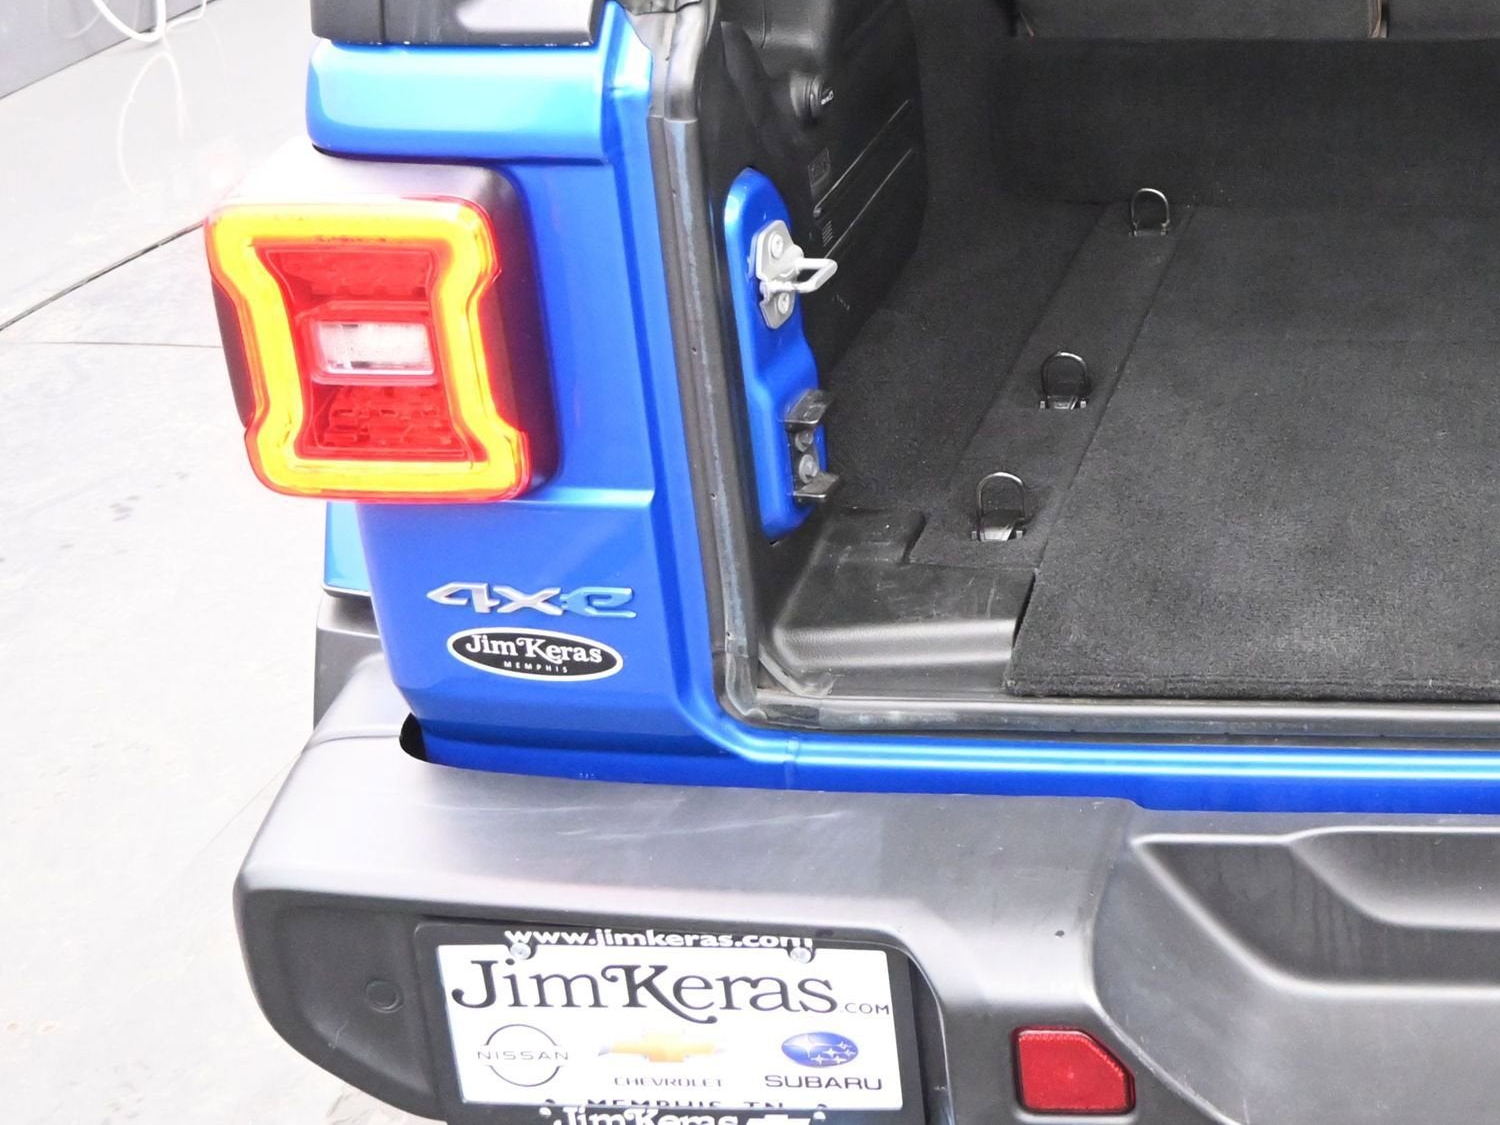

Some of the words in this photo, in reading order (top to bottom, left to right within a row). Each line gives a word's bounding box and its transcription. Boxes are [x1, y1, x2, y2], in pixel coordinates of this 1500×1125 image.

[503, 660, 568, 674] MEMPHIS
[504, 928, 813, 950] www.jimkeras.com
[477, 1050, 569, 1061] NISSAN
[614, 1076, 724, 1088] CHEVROLET
[764, 1074, 882, 1090] SUBARU
